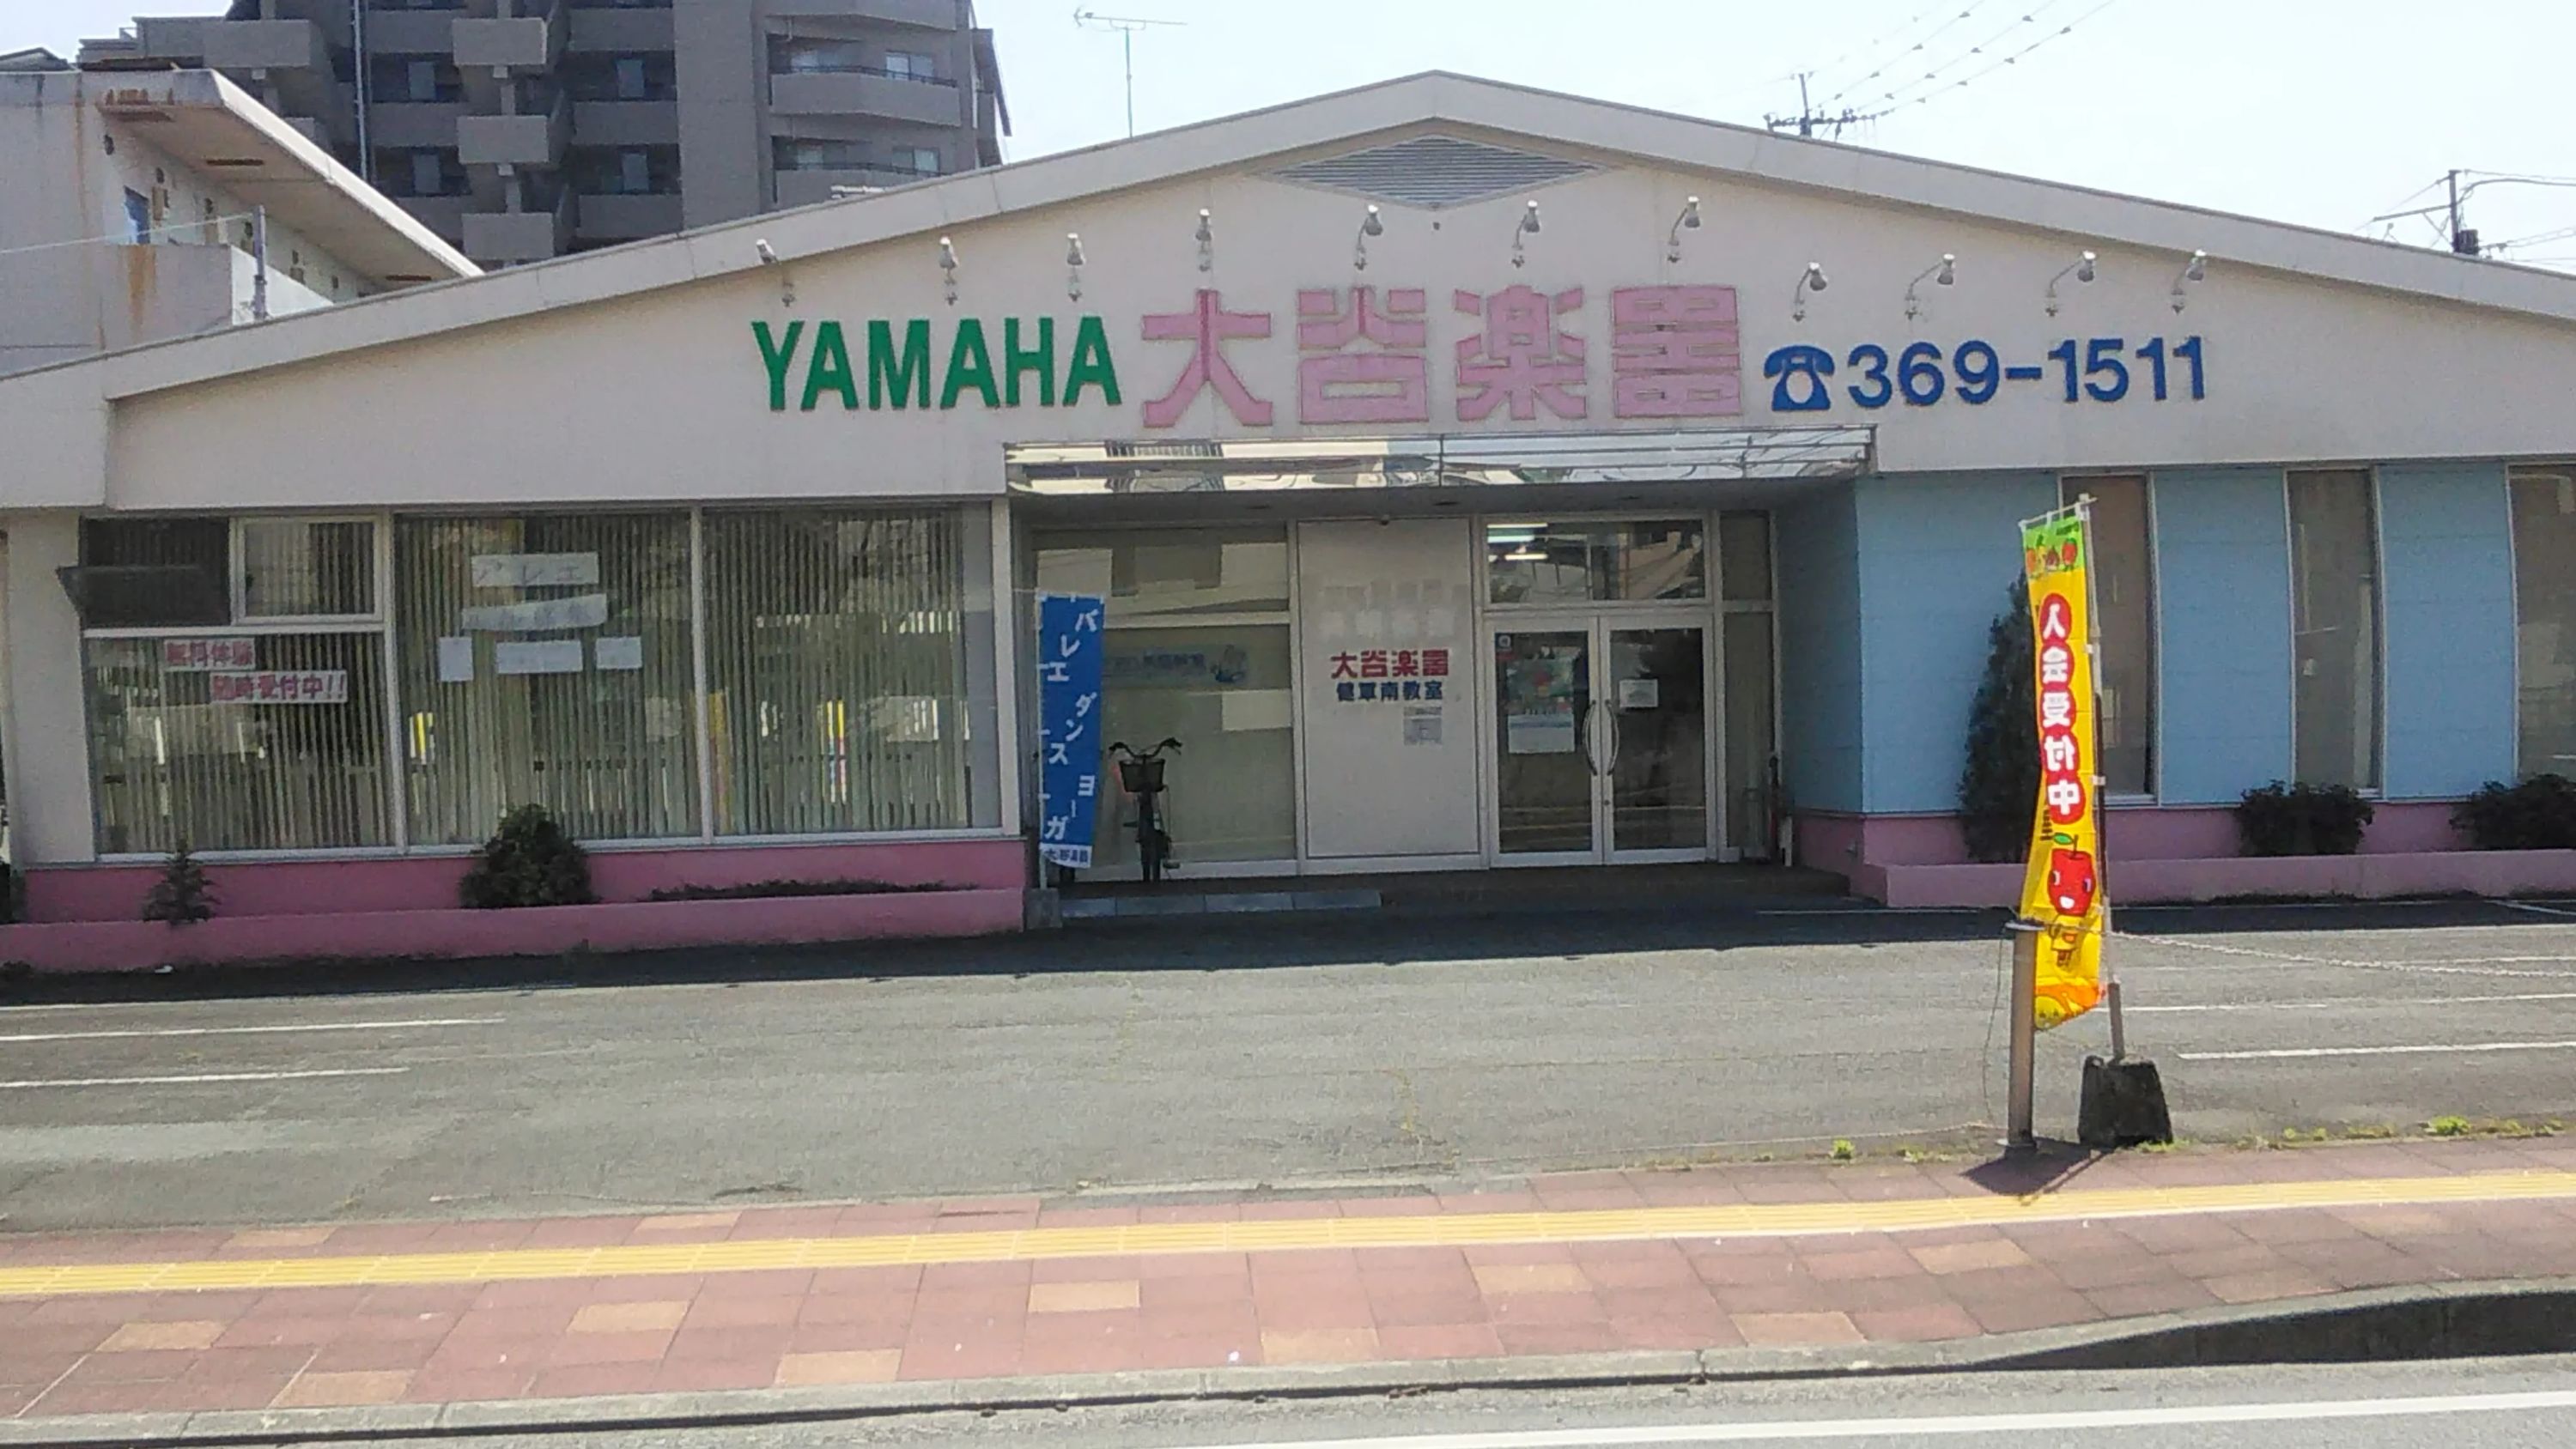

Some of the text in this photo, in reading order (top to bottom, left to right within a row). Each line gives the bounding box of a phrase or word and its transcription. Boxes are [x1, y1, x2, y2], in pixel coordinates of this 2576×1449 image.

[751, 315, 1122, 411] YAMAHA
[1142, 287, 1742, 427] 大谷楽器
[1847, 336, 2204, 409] 369-1511
[1048, 609, 1099, 682] バレエ
[1331, 650, 1449, 679] 大谷楽器
[1048, 692, 1097, 765] ダンス
[1044, 775, 1095, 840] ヨーガ
